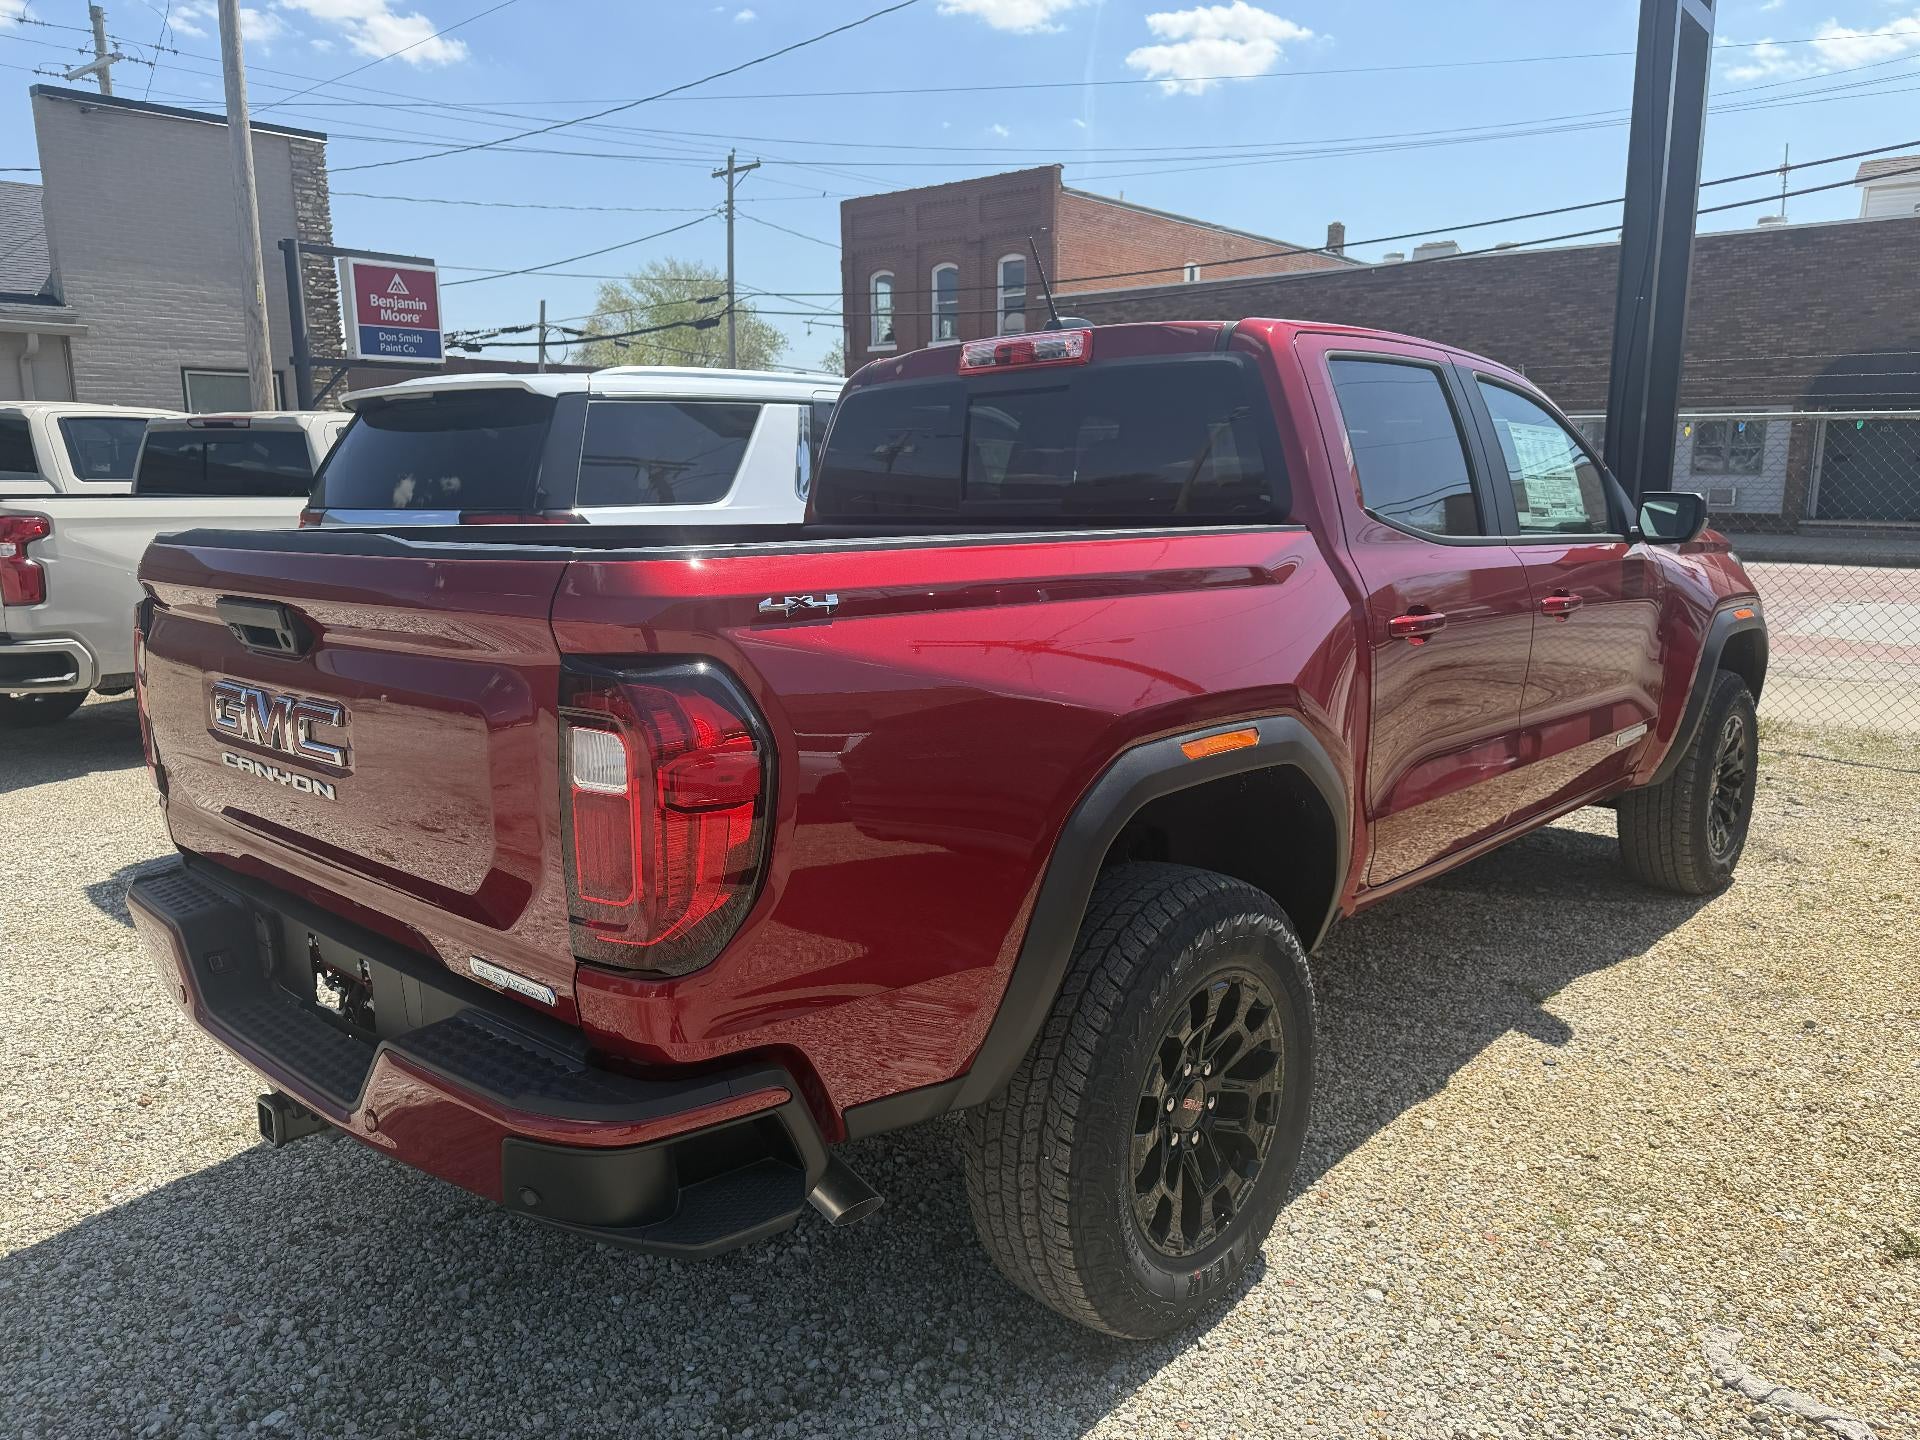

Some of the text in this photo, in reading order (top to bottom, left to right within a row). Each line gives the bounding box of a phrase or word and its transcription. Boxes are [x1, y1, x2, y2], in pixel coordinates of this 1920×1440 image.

[369, 294, 427, 311] Benjamin
[380, 309, 420, 323] Moore
[378, 332, 423, 344] Don Smith
[380, 343, 417, 354] Paint Co.
[210, 680, 348, 767] GMC
[221, 751, 337, 801] CANYON
